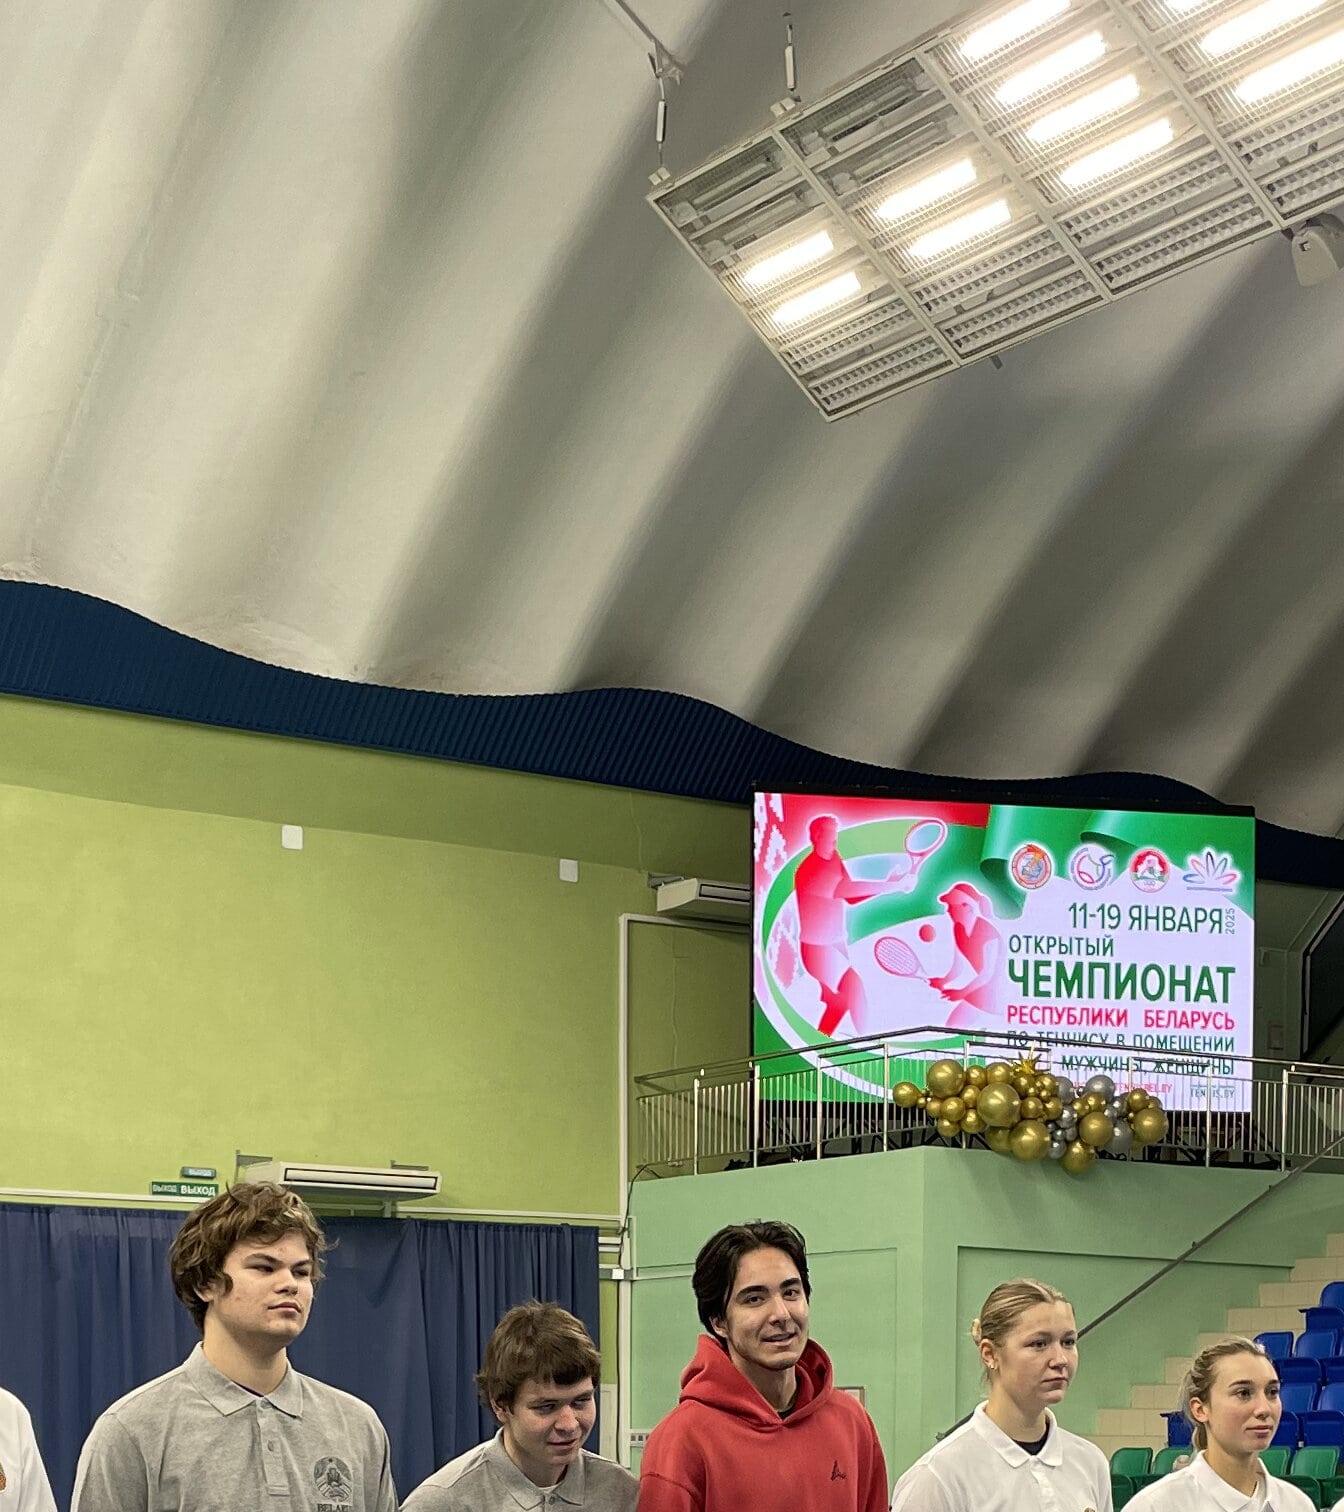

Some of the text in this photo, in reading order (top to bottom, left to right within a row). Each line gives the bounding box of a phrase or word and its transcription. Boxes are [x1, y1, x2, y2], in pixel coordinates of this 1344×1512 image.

[1068, 902, 1223, 934] 11-19 ЯНВАРЯ
[1225, 907, 1235, 935] 2025
[1008, 933, 1115, 957] ОТКРЫТЫЙ
[1008, 959, 1236, 1004] ЧЕМПИОНАТ
[1007, 1005, 1235, 1031] РЕСПУБЛИКИ БЕЛАРУСЬ
[1133, 1034, 1235, 1052] ПОМЕЩЕНИИ
[1190, 1087, 1235, 1098] TENIS.BY
[180, 1184, 216, 1197] ВЫХОД
